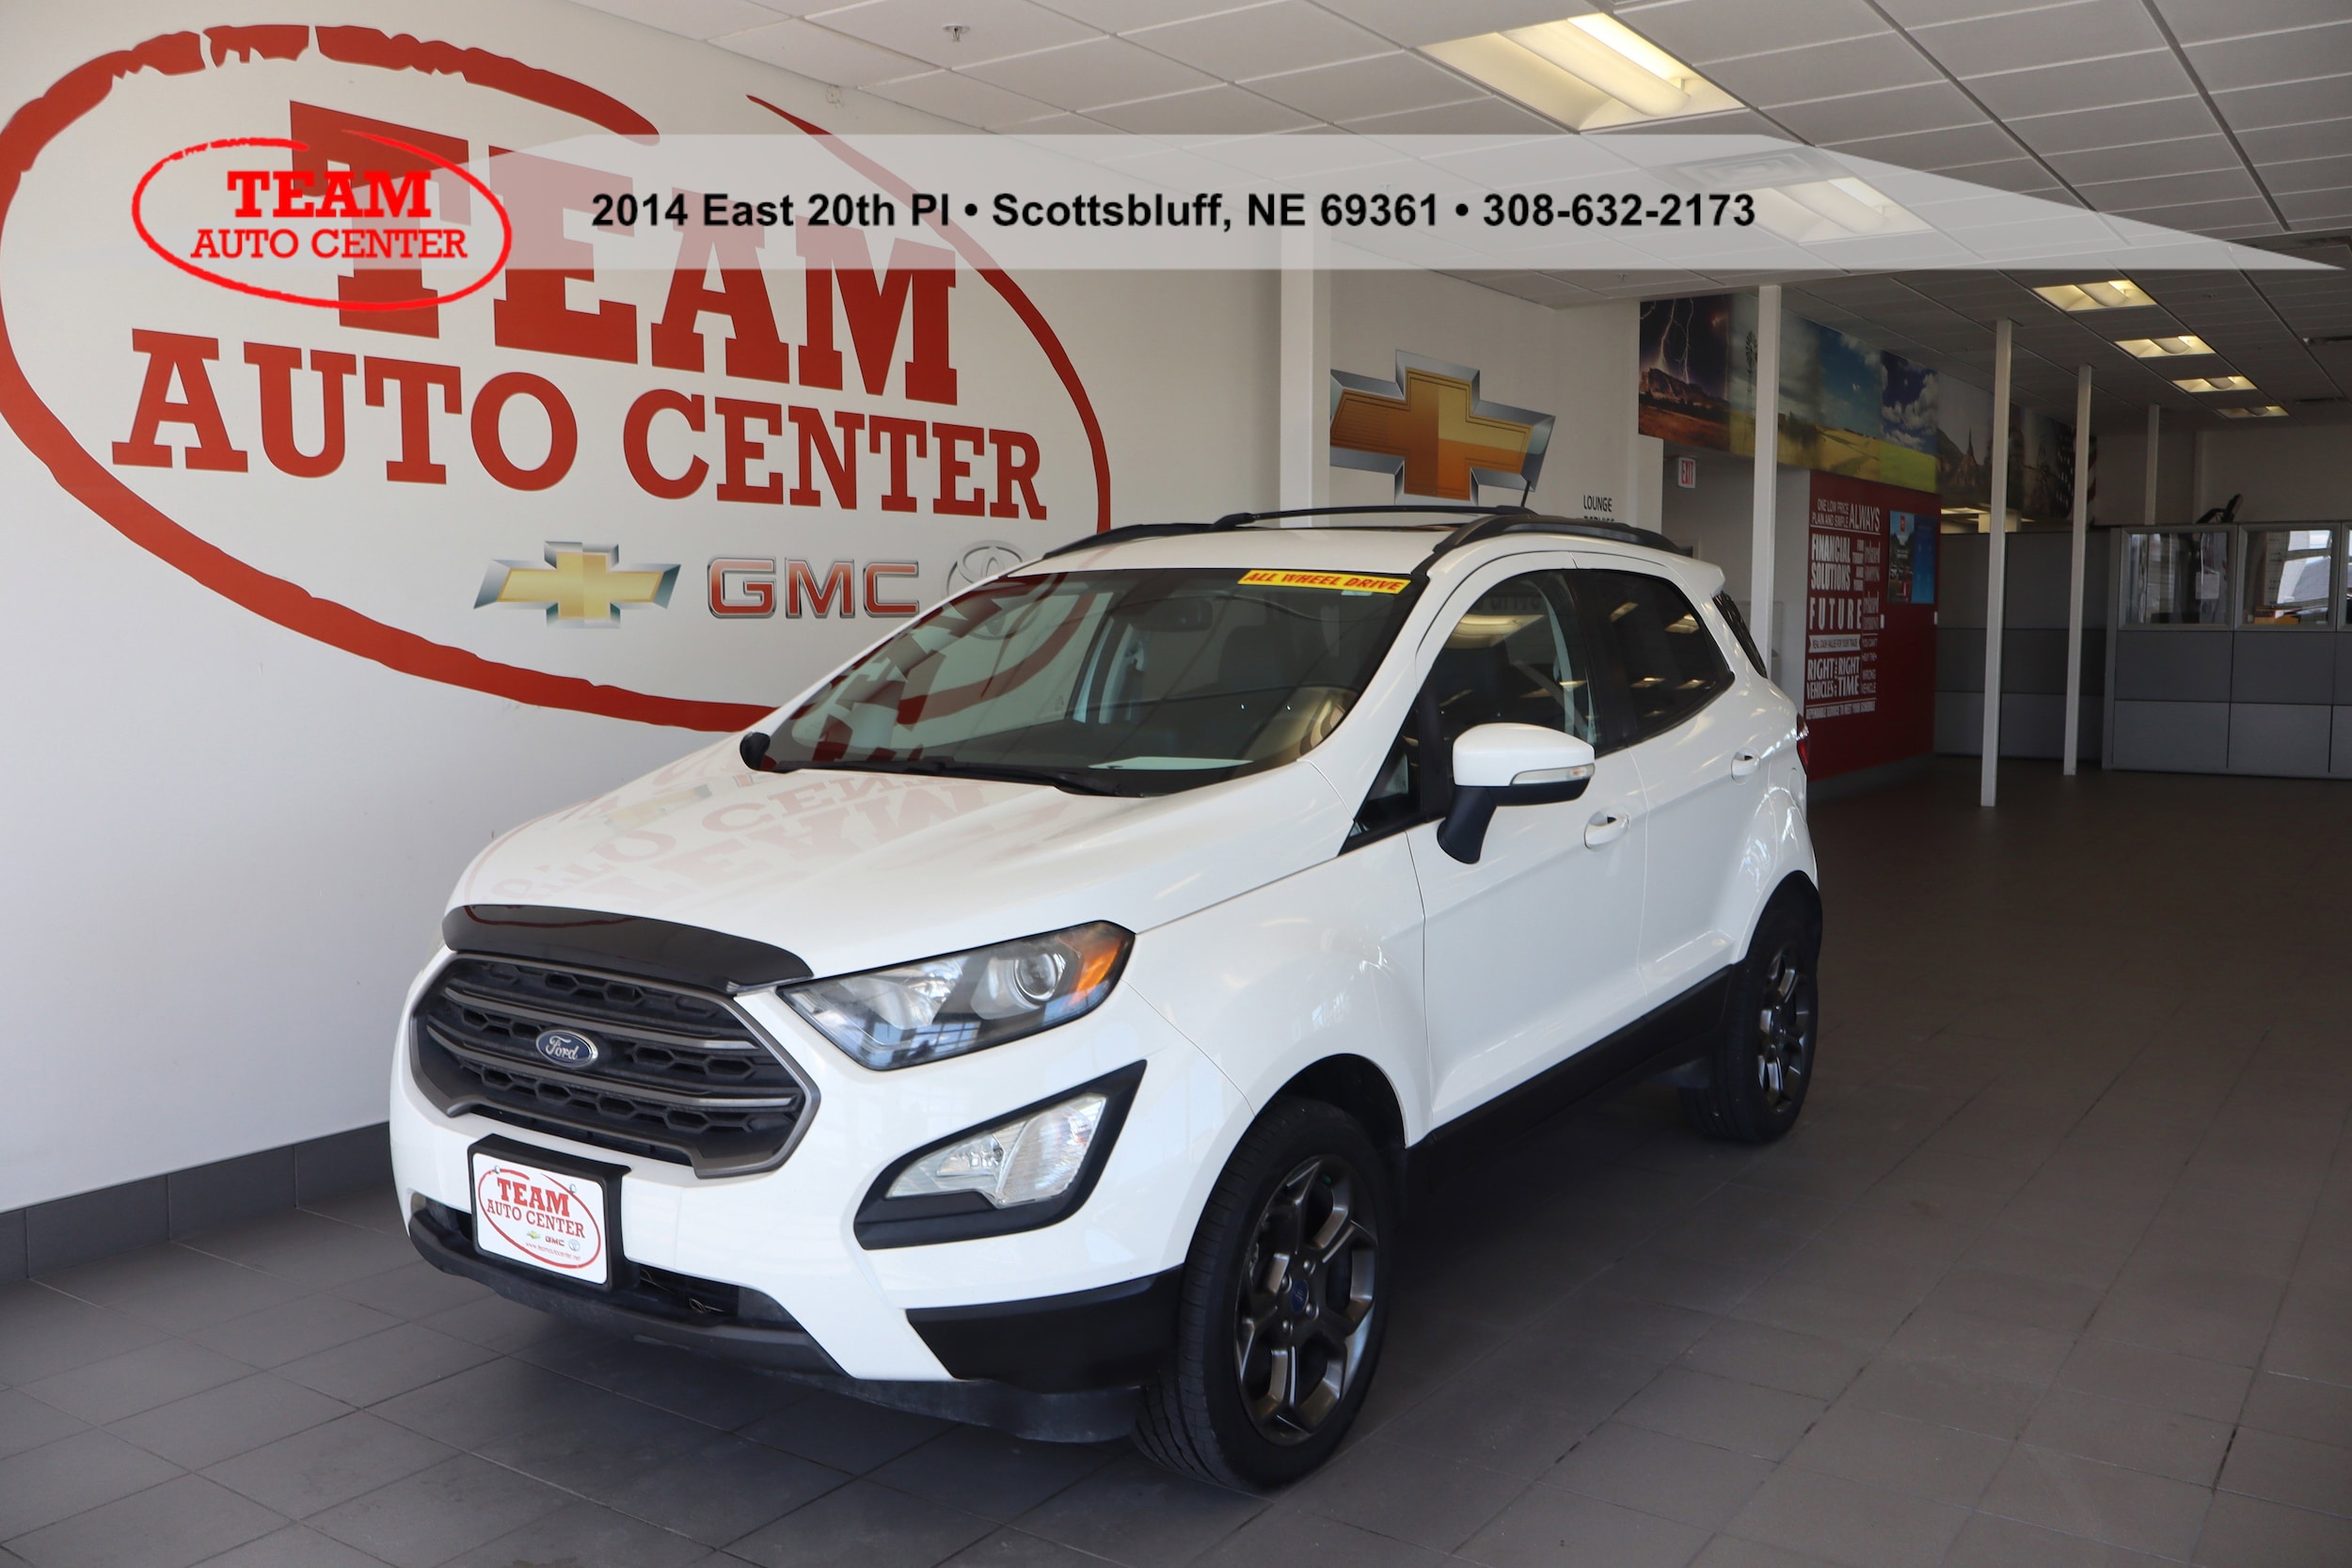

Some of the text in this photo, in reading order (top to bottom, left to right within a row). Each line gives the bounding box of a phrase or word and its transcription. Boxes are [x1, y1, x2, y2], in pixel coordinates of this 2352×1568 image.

[290, 101, 958, 405] TEAM
[112, 328, 1047, 520] AUTO CENTER
[1681, 460, 1694, 485] EXIT
[1582, 495, 1613, 513] LOUNGE
[1850, 503, 1881, 532] ALWAYS
[1811, 533, 1851, 564] FINANCIAL
[707, 557, 919, 619] GMC
[1242, 573, 1404, 591] ALL WHEEL DRIVE
[1811, 562, 1851, 592] SOLUTIONS
[1809, 597, 1862, 631] FUTURE
[1807, 658, 1835, 680] RIGHT
[1837, 657, 1860, 675] RIGHT
[1806, 679, 1834, 700] VEHICLES
[1838, 675, 1859, 697] TIME
[546, 1036, 580, 1060] Ford
[497, 1178, 570, 1217] TEAM
[487, 1198, 586, 1239] AUTO CENTER
[545, 1236, 565, 1247] GMC
